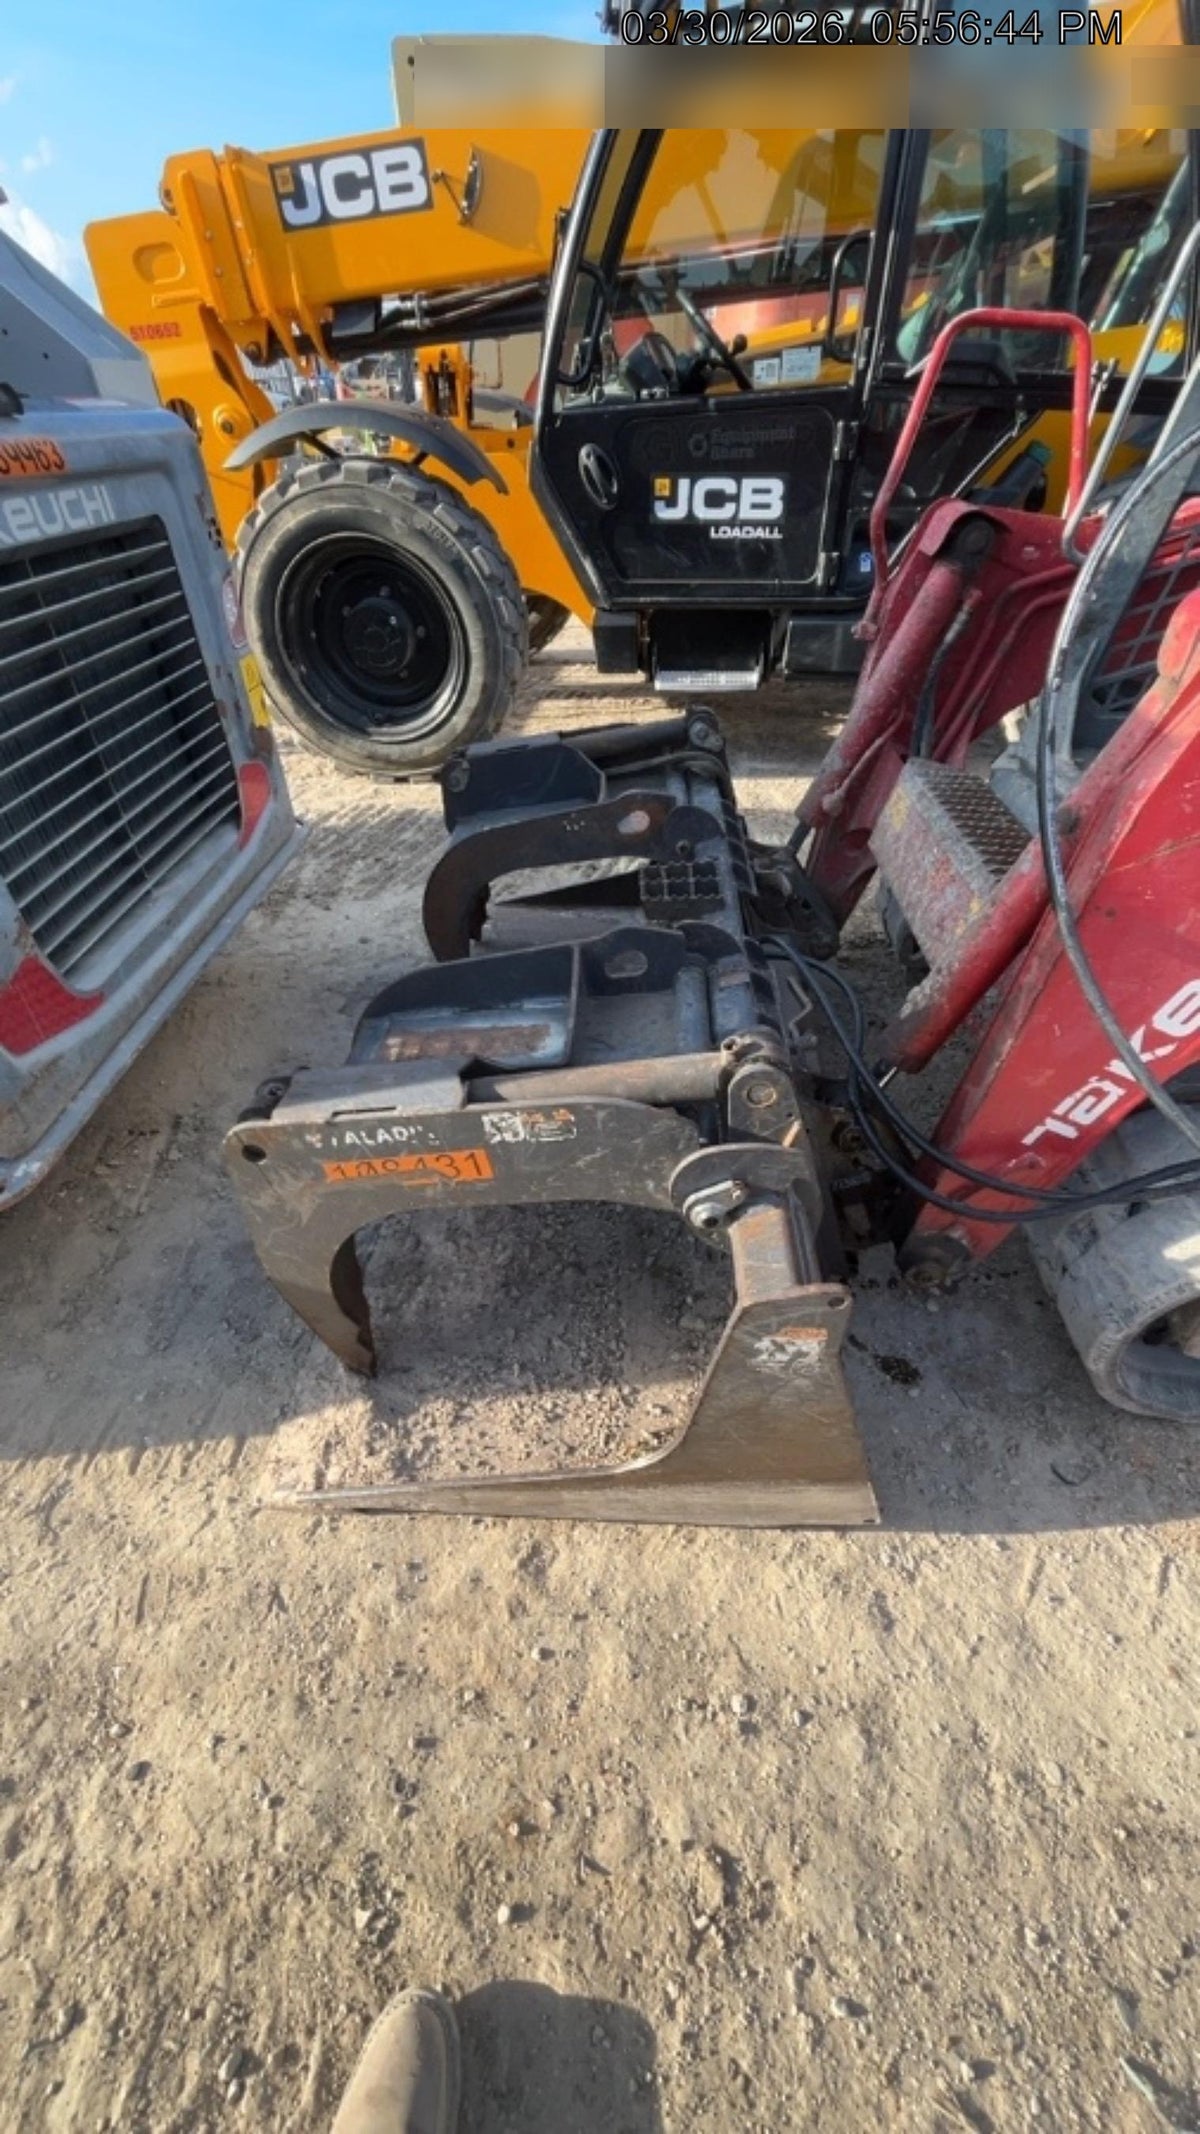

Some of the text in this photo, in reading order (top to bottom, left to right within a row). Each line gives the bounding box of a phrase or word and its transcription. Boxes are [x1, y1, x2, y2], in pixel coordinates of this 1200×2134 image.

[279, 145, 428, 227] JCB
[653, 477, 784, 520] JCB
[709, 525, 783, 539] LOADALL
